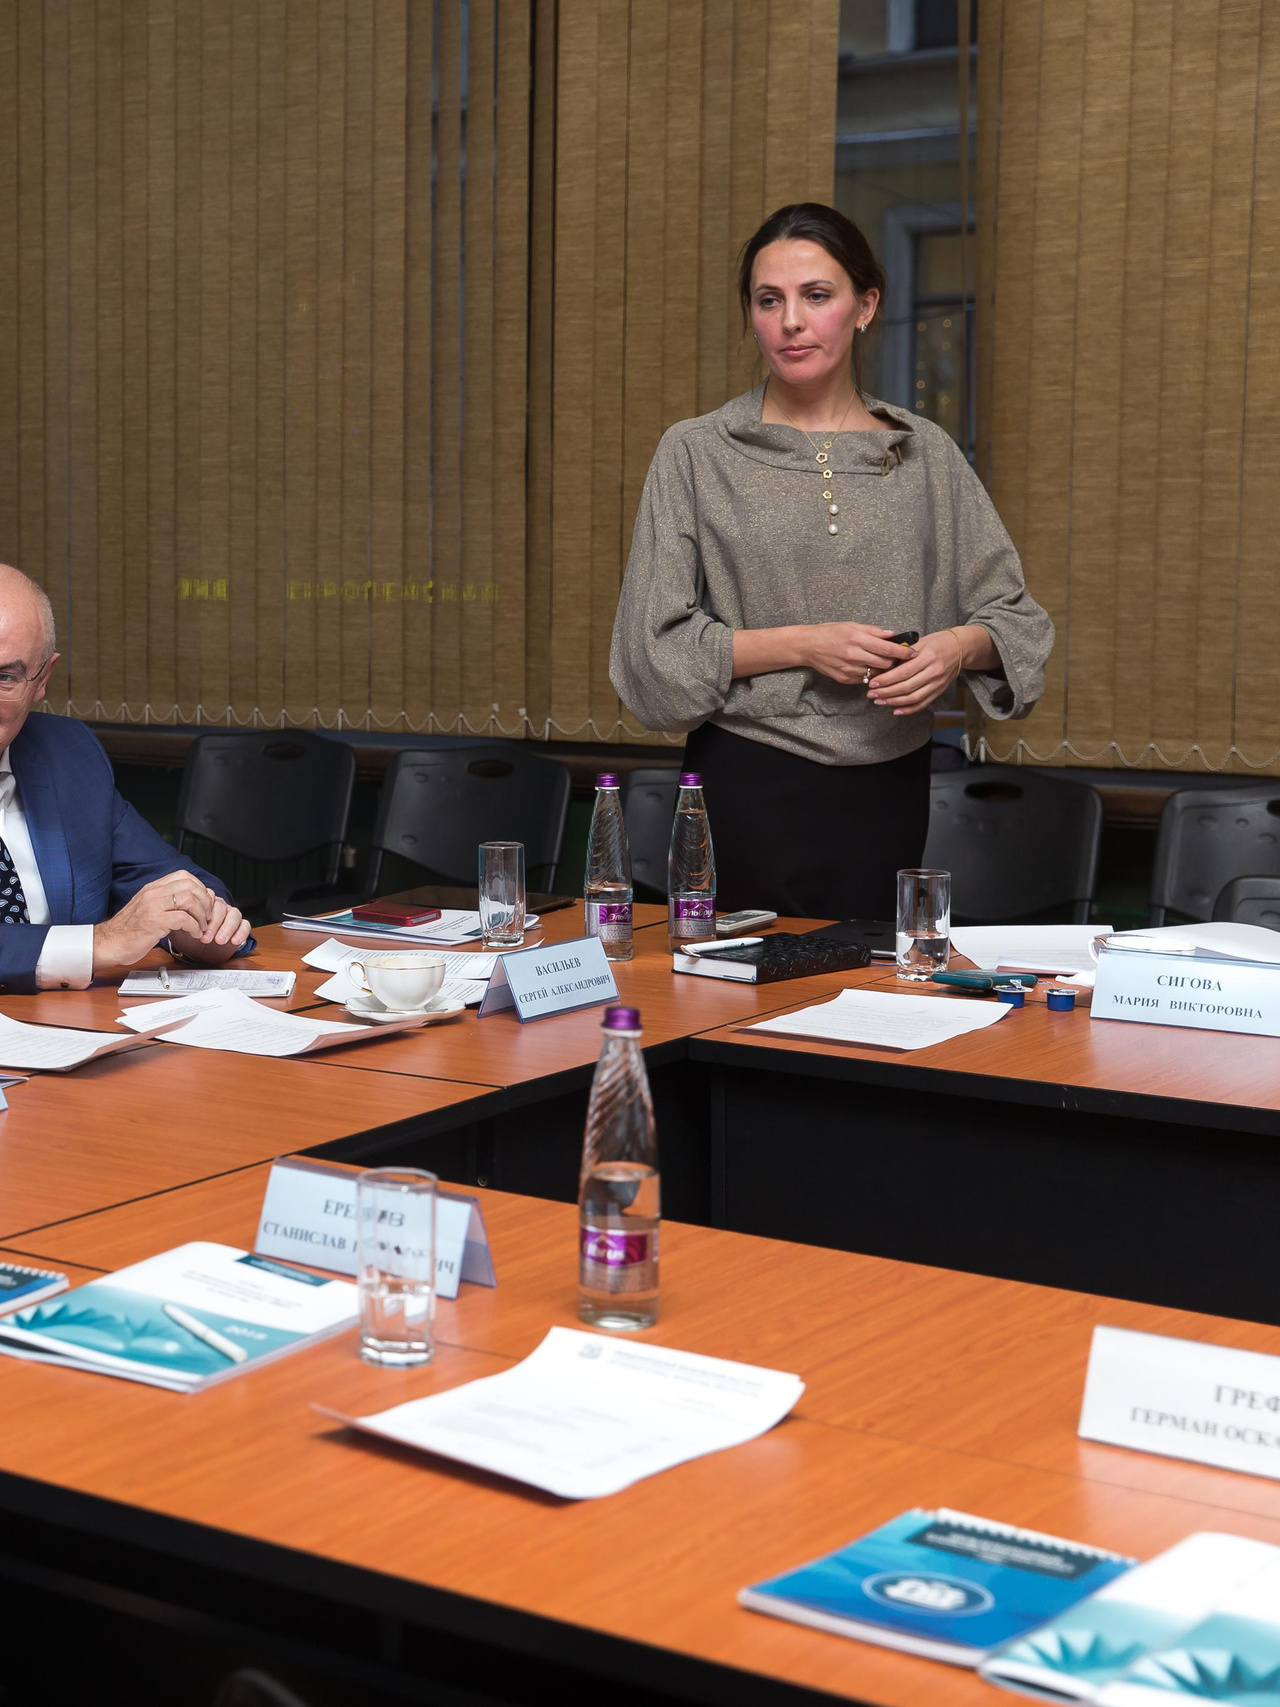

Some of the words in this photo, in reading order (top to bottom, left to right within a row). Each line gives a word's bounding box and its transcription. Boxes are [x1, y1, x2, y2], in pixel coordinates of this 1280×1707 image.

[535, 957, 582, 977] ВАСИЛЬЕВ
[519, 988, 549, 1004] СЕРГЕЙ
[551, 974, 611, 997] АЛЕКСАНДРОВИЧ
[1157, 974, 1223, 992] СИГОВА
[1112, 995, 1160, 1009] МАРИЯ
[1169, 1000, 1263, 1019] ВИКТОРОВНА
[263, 1220, 347, 1251] СТАНИСЛАВ
[1214, 1384, 1280, 1414] ГРЕФ
[1130, 1406, 1218, 1437] ГЕРМАН
